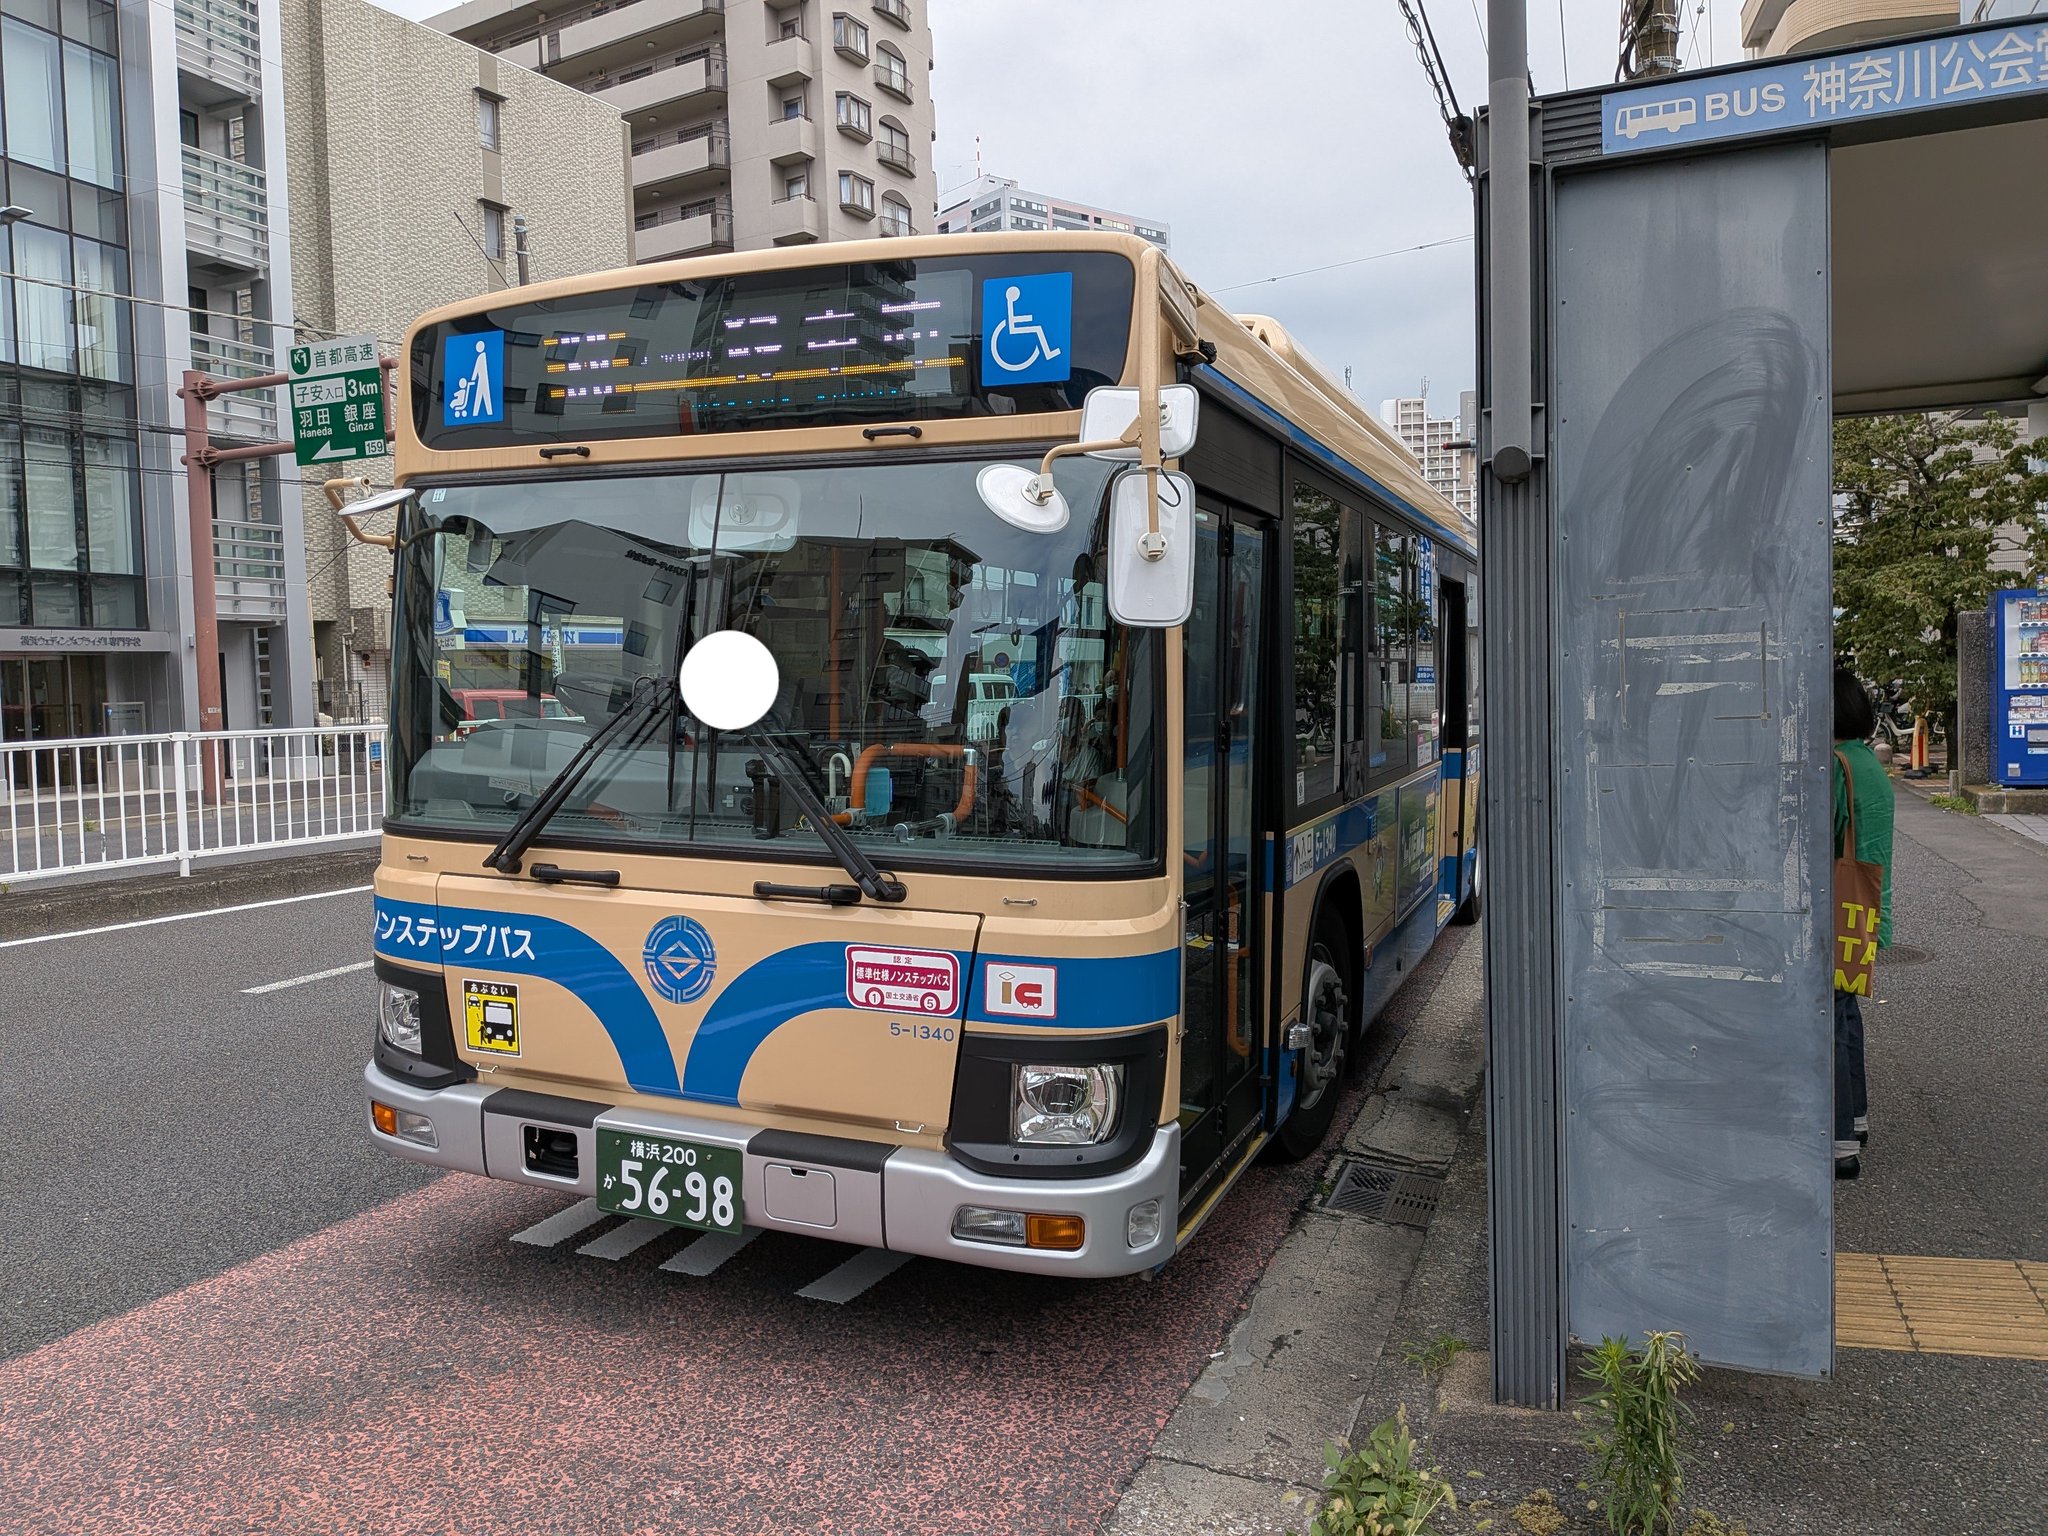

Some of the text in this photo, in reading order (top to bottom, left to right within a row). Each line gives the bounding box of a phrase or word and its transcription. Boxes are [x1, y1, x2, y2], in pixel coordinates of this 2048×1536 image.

[1705, 83, 1786, 121] BUS
[314, 343, 374, 368] 首都高速
[296, 385, 344, 403] 子安入口
[299, 402, 377, 427] 羽田 銀座
[300, 422, 374, 439] Haneda Ginza
[366, 441, 383, 453] 159
[1315, 824, 1337, 863] 5-1340
[374, 909, 535, 960] ノンステップバス
[893, 955, 912, 964] 認定
[856, 966, 950, 986] 標準仕様ノンステップバス
[470, 983, 509, 995] あぶない
[885, 992, 919, 1002] 国土交通省
[927, 998, 934, 1008] 5
[890, 1022, 955, 1042] 5-1340
[603, 1160, 734, 1227] か 56-98
